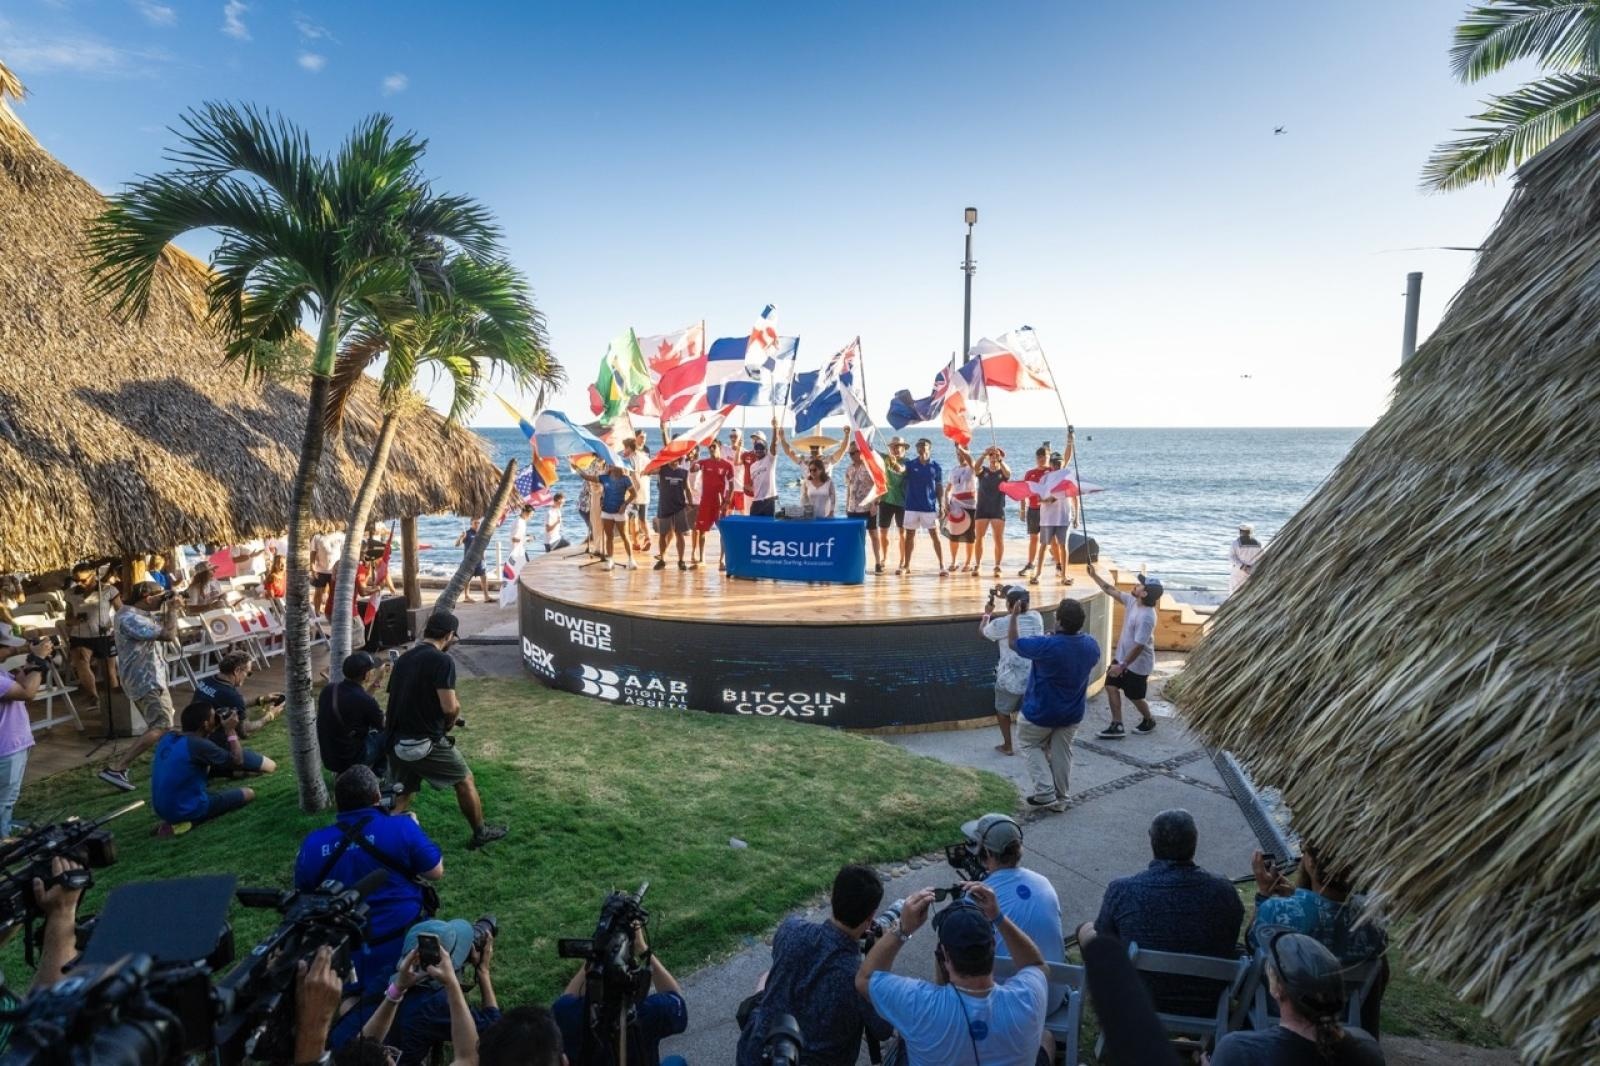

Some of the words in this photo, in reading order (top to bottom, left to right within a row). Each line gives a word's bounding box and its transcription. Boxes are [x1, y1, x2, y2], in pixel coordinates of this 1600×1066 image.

[751, 534, 836, 558] isasurf
[544, 608, 612, 638] POWER
[570, 629, 613, 652] ADE
[624, 675, 689, 694] AAB
[624, 686, 689, 704] DIGITAL
[722, 688, 846, 704] BITCOIN
[735, 702, 834, 717] COAST
